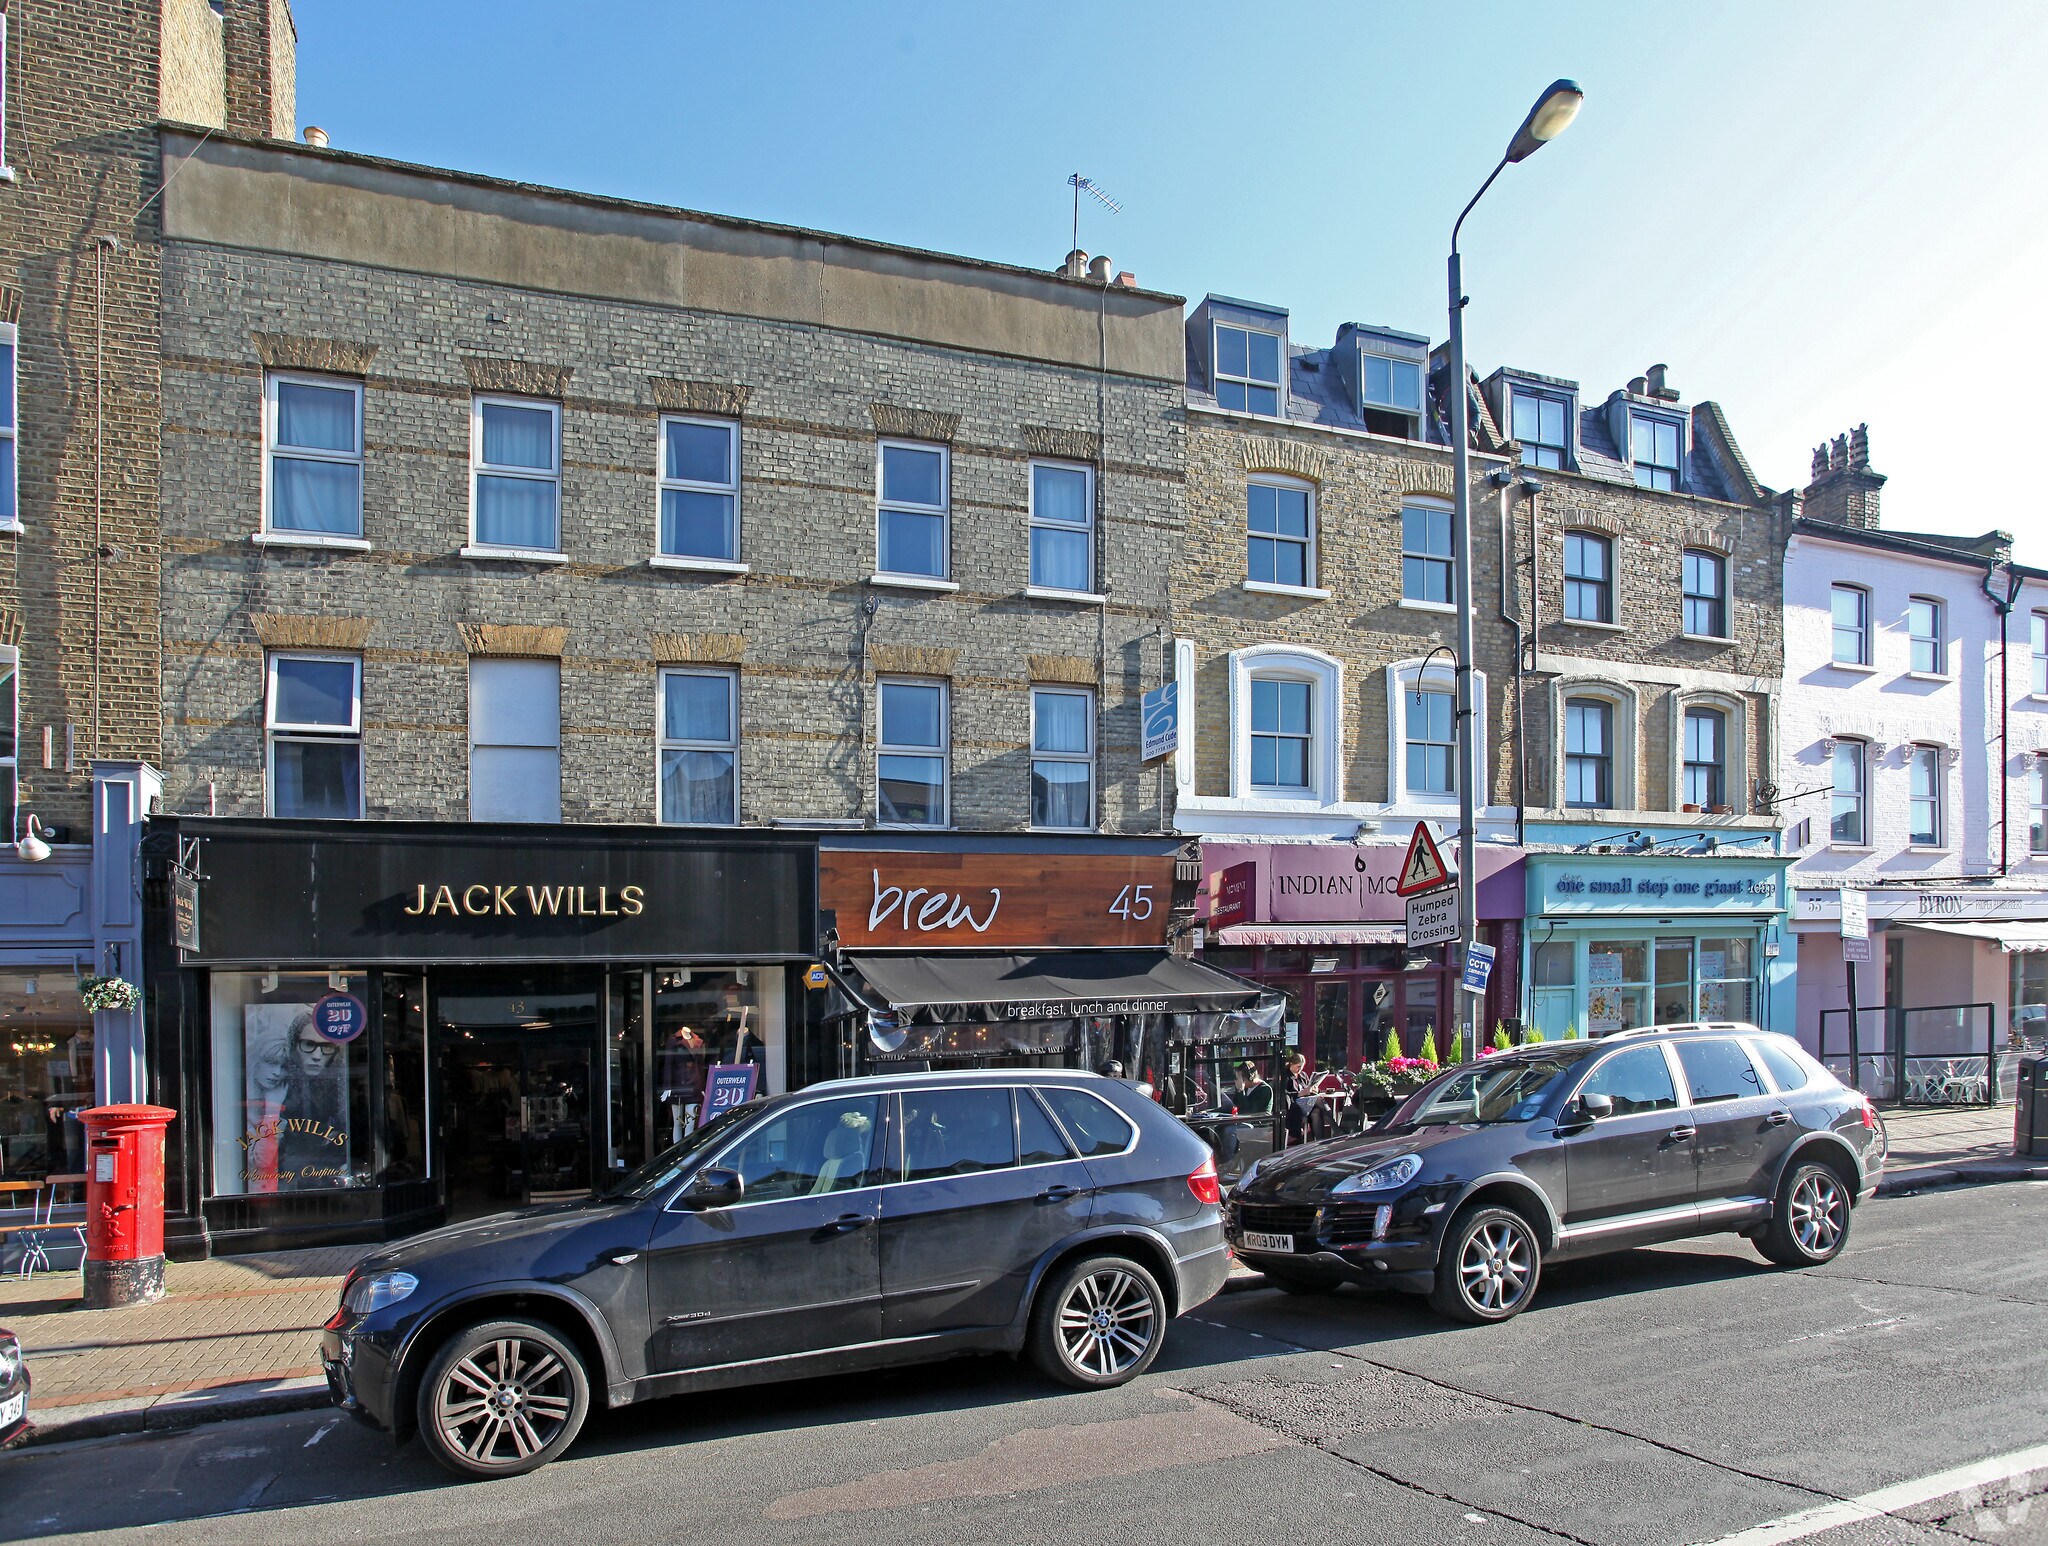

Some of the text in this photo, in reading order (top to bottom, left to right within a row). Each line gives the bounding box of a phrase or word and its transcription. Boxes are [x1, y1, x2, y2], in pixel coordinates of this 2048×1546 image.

[1145, 735, 1164, 749] Edmund
[1278, 875, 1353, 895] INDIAN
[1557, 877, 1777, 898] one small step one giant leap
[403, 884, 645, 916] JACK WILLS
[868, 868, 1001, 932] brew
[1108, 884, 1154, 921] 45
[1412, 894, 1454, 914] Humped
[1918, 895, 1963, 914] BYRON
[1418, 912, 1447, 927] Zebra
[1241, 931, 1338, 944] INDIAN MOMENT
[1411, 924, 1455, 941] Crossing
[1469, 958, 1491, 971] CCTV
[327, 1009, 352, 1022] 20
[1007, 998, 1169, 1017] breakfast, lunch and dinner
[716, 1076, 747, 1085] OUTERWEAR
[713, 1087, 746, 1107] 20
[236, 1118, 349, 1151] JACK WILLS
[1269, 1235, 1289, 1250] DYM
